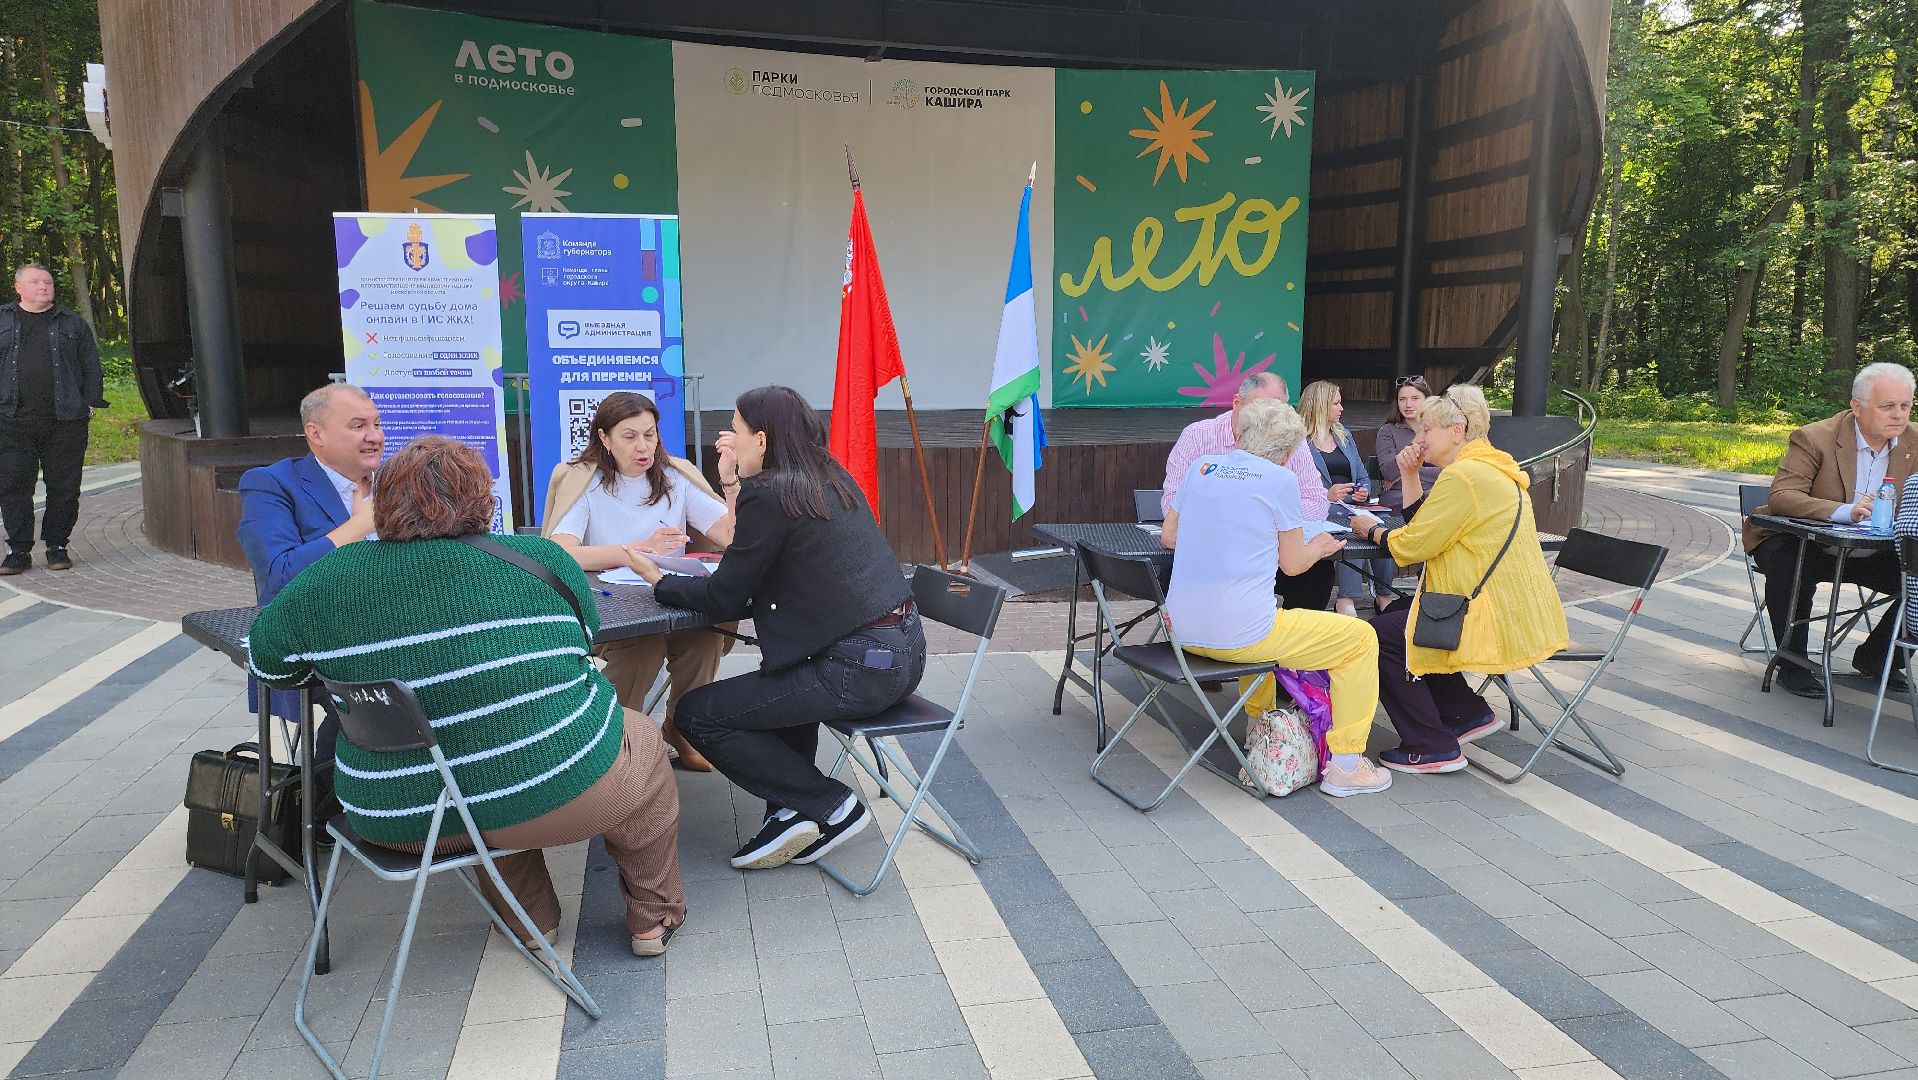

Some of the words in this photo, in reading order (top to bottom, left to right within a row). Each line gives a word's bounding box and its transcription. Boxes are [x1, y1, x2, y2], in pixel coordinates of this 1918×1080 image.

[752, 70, 798, 84] ПАРКИ
[752, 85, 860, 103] ПОДМОСКОВЬЯ
[925, 86, 984, 97] ГОРОДСКОЙ
[985, 89, 1012, 98] ПАРК
[925, 96, 983, 109] КАШИРА
[562, 240, 597, 249] Команда
[563, 248, 612, 256] губернатора
[360, 302, 405, 311] Решаем
[408, 302, 447, 312] судьбу
[366, 315, 408, 324] онлайн
[421, 315, 444, 324] ГИС
[446, 315, 474, 324] ЖКХ!
[552, 355, 659, 366] ОБЪЕДИНЯЕМСЯ
[561, 371, 590, 383] ДЛЯ
[591, 372, 652, 382] ПЕРЕМЕН
